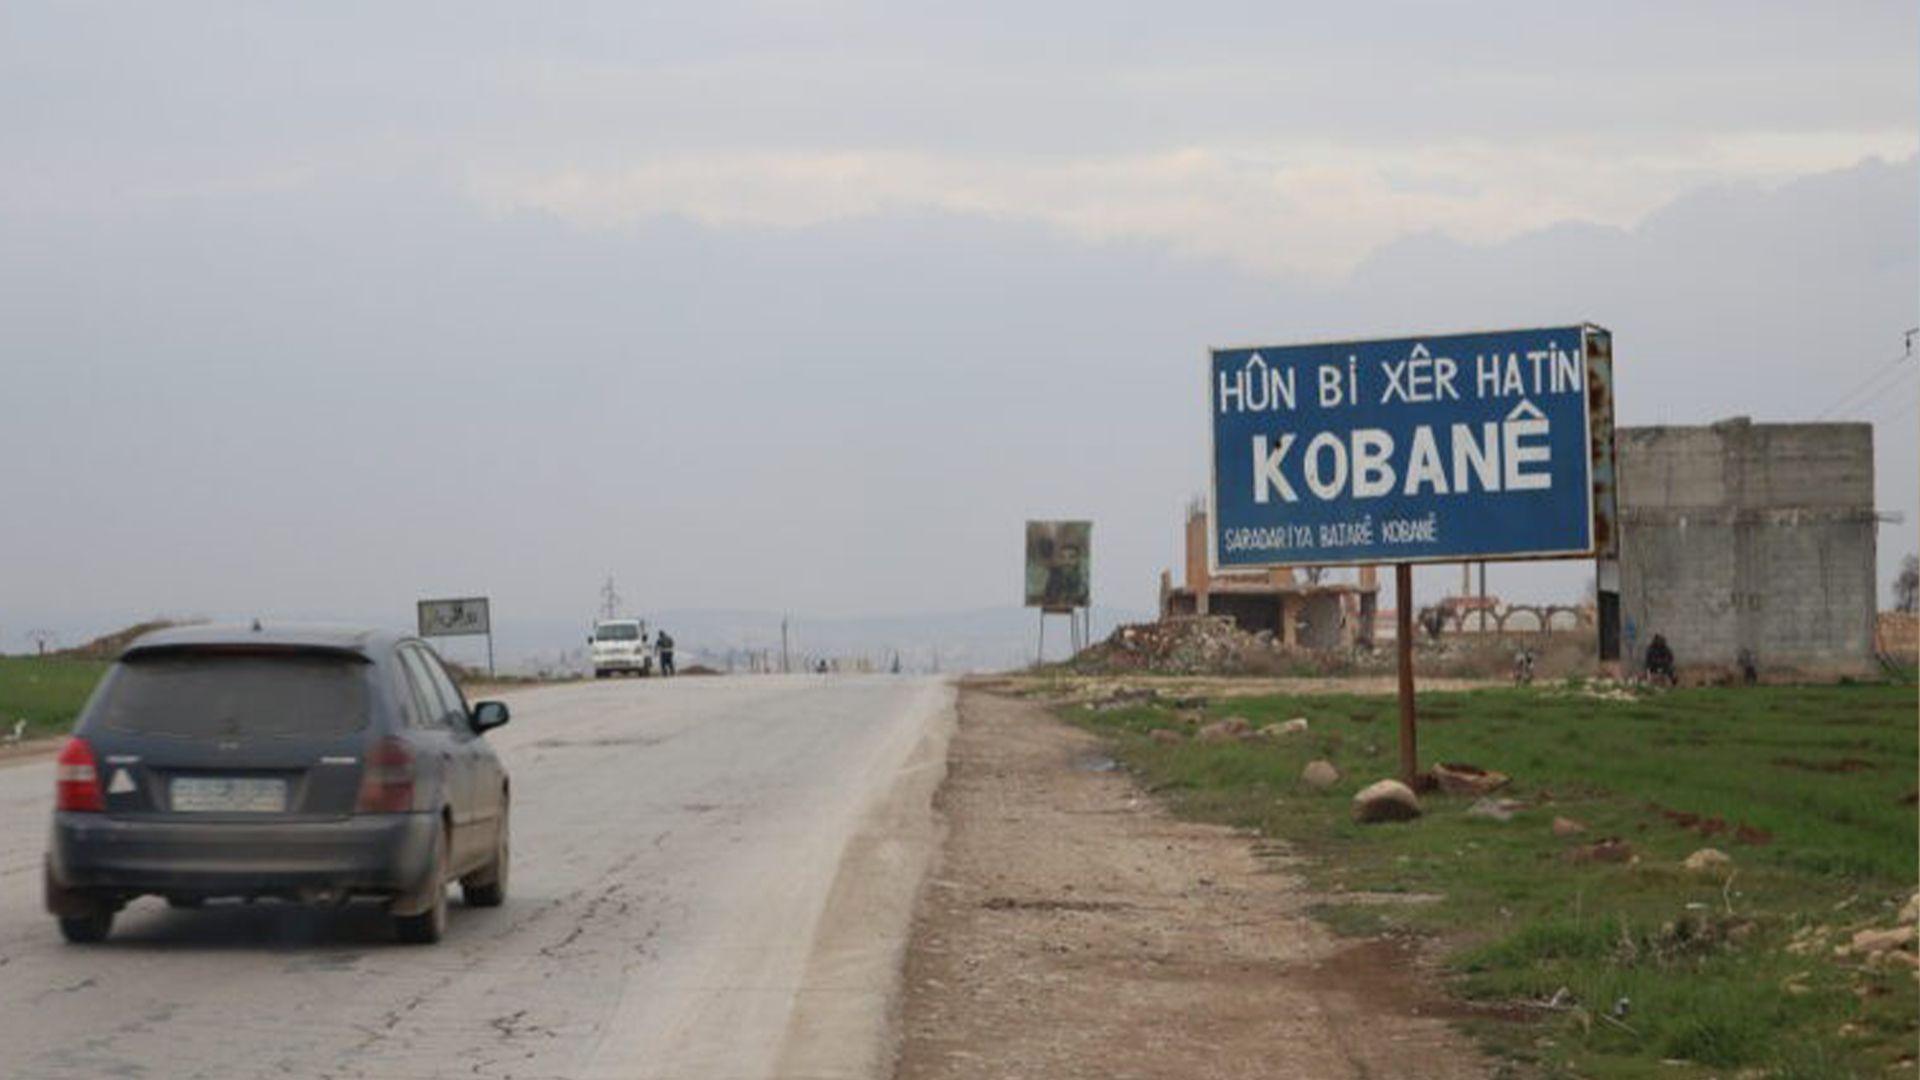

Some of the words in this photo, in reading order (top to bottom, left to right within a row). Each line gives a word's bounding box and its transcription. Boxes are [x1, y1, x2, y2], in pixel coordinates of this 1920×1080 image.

[1220, 353, 1296, 413] HÛN
[1381, 342, 1460, 404] XÊR
[1252, 399, 1552, 504] KOBANÊ
